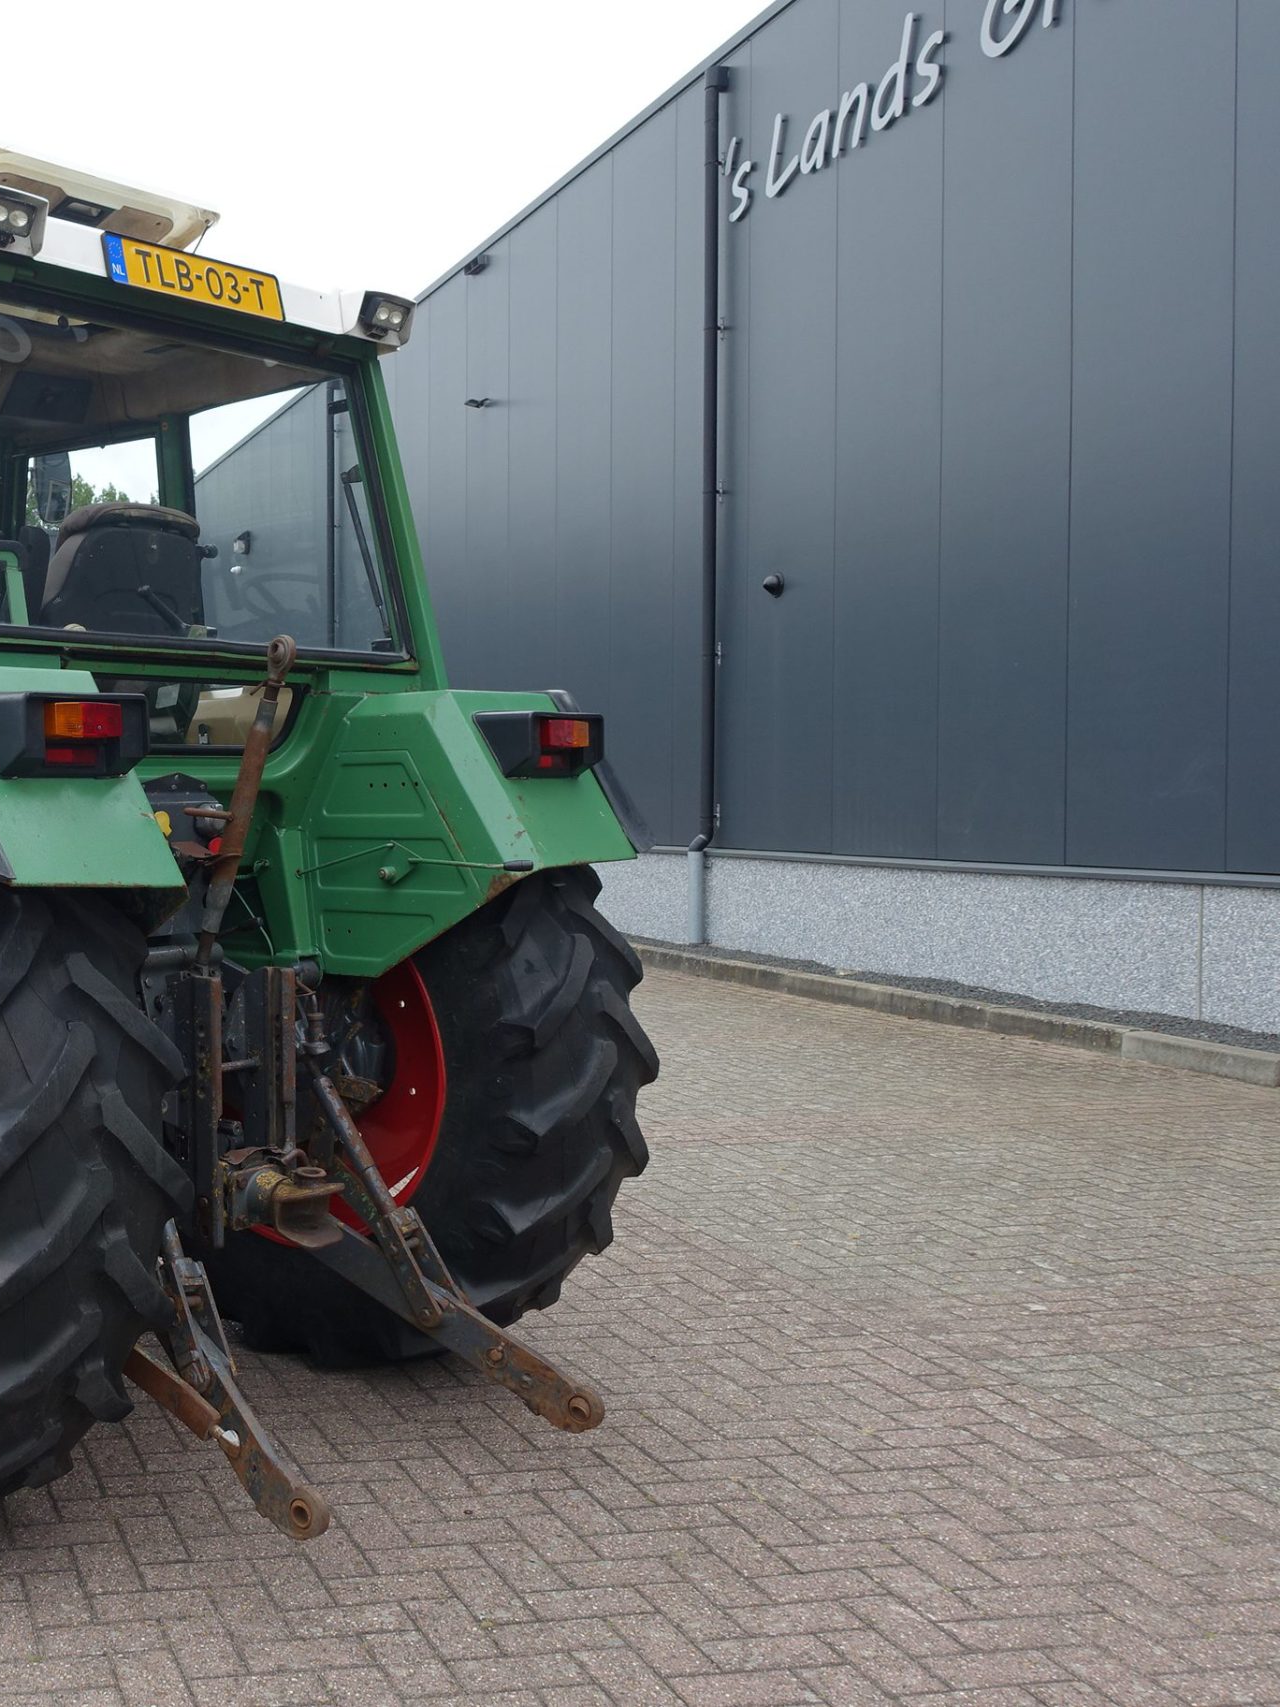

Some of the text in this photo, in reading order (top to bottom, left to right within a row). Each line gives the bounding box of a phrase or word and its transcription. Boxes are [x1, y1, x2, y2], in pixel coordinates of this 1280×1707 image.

[765, 12, 946, 198] Lands
[111, 262, 126, 277] NL
[134, 247, 265, 311] TLB-03-T
